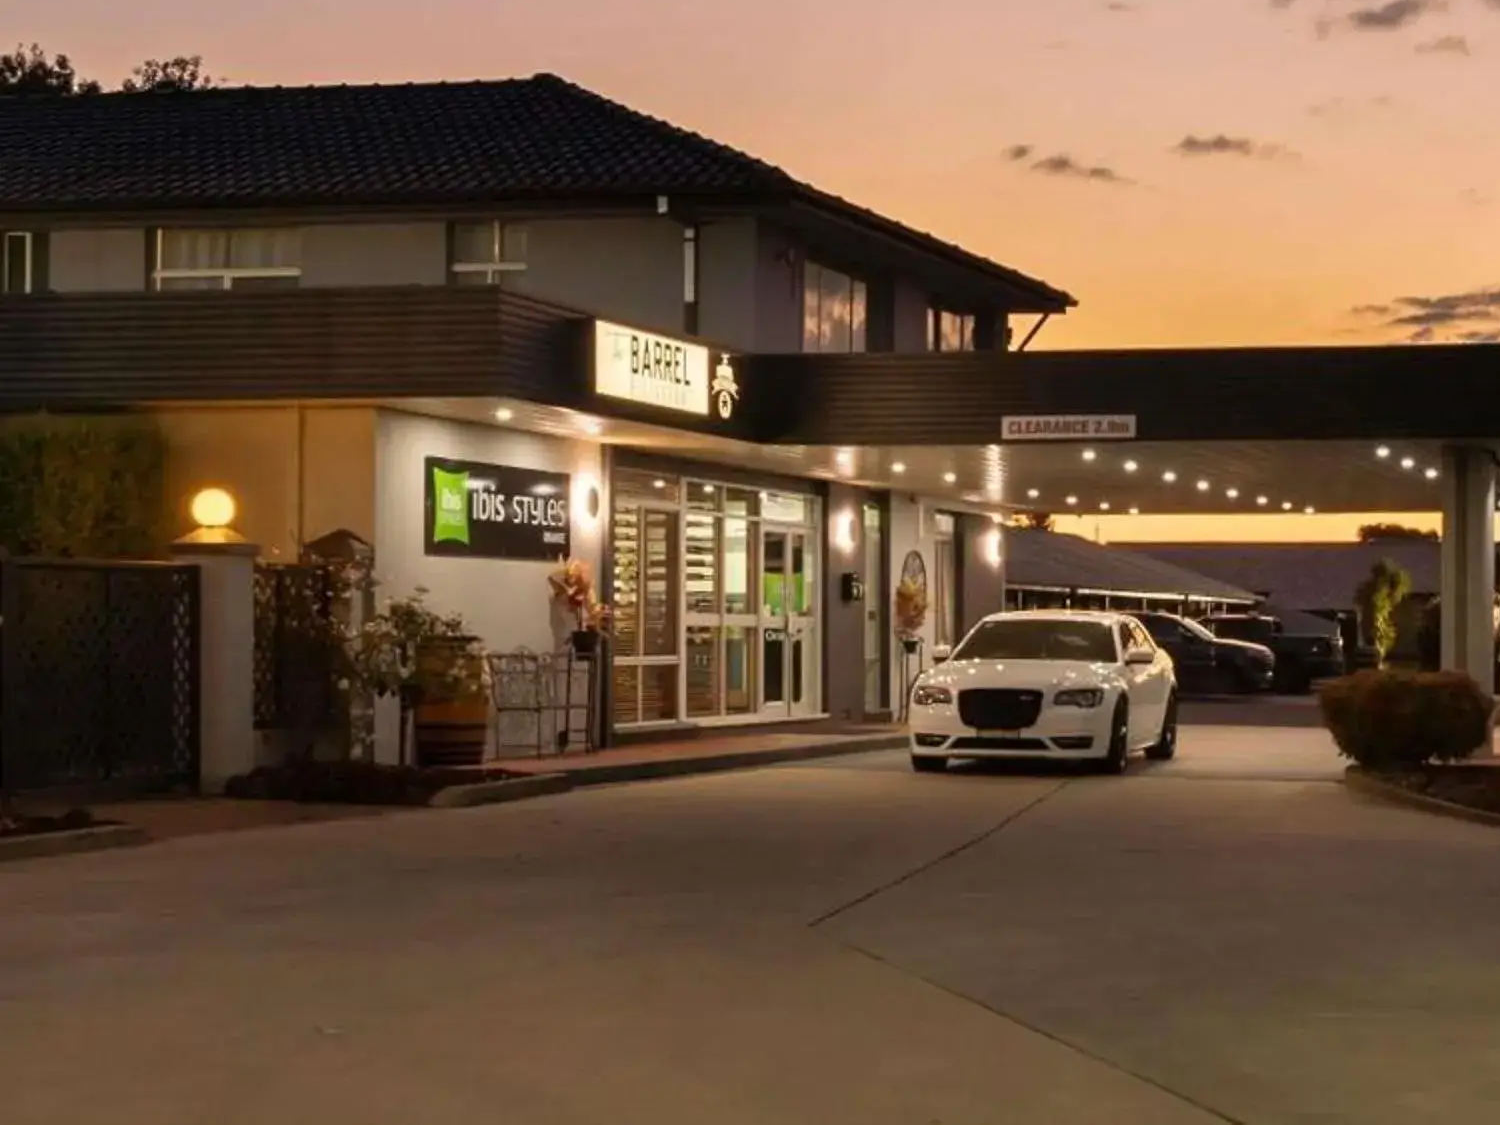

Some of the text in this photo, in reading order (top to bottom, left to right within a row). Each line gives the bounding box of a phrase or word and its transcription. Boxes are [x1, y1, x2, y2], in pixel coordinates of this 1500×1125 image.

[631, 335, 692, 387] BARREL
[1007, 420, 1089, 435] CLEARANCE
[472, 484, 505, 523] ibis
